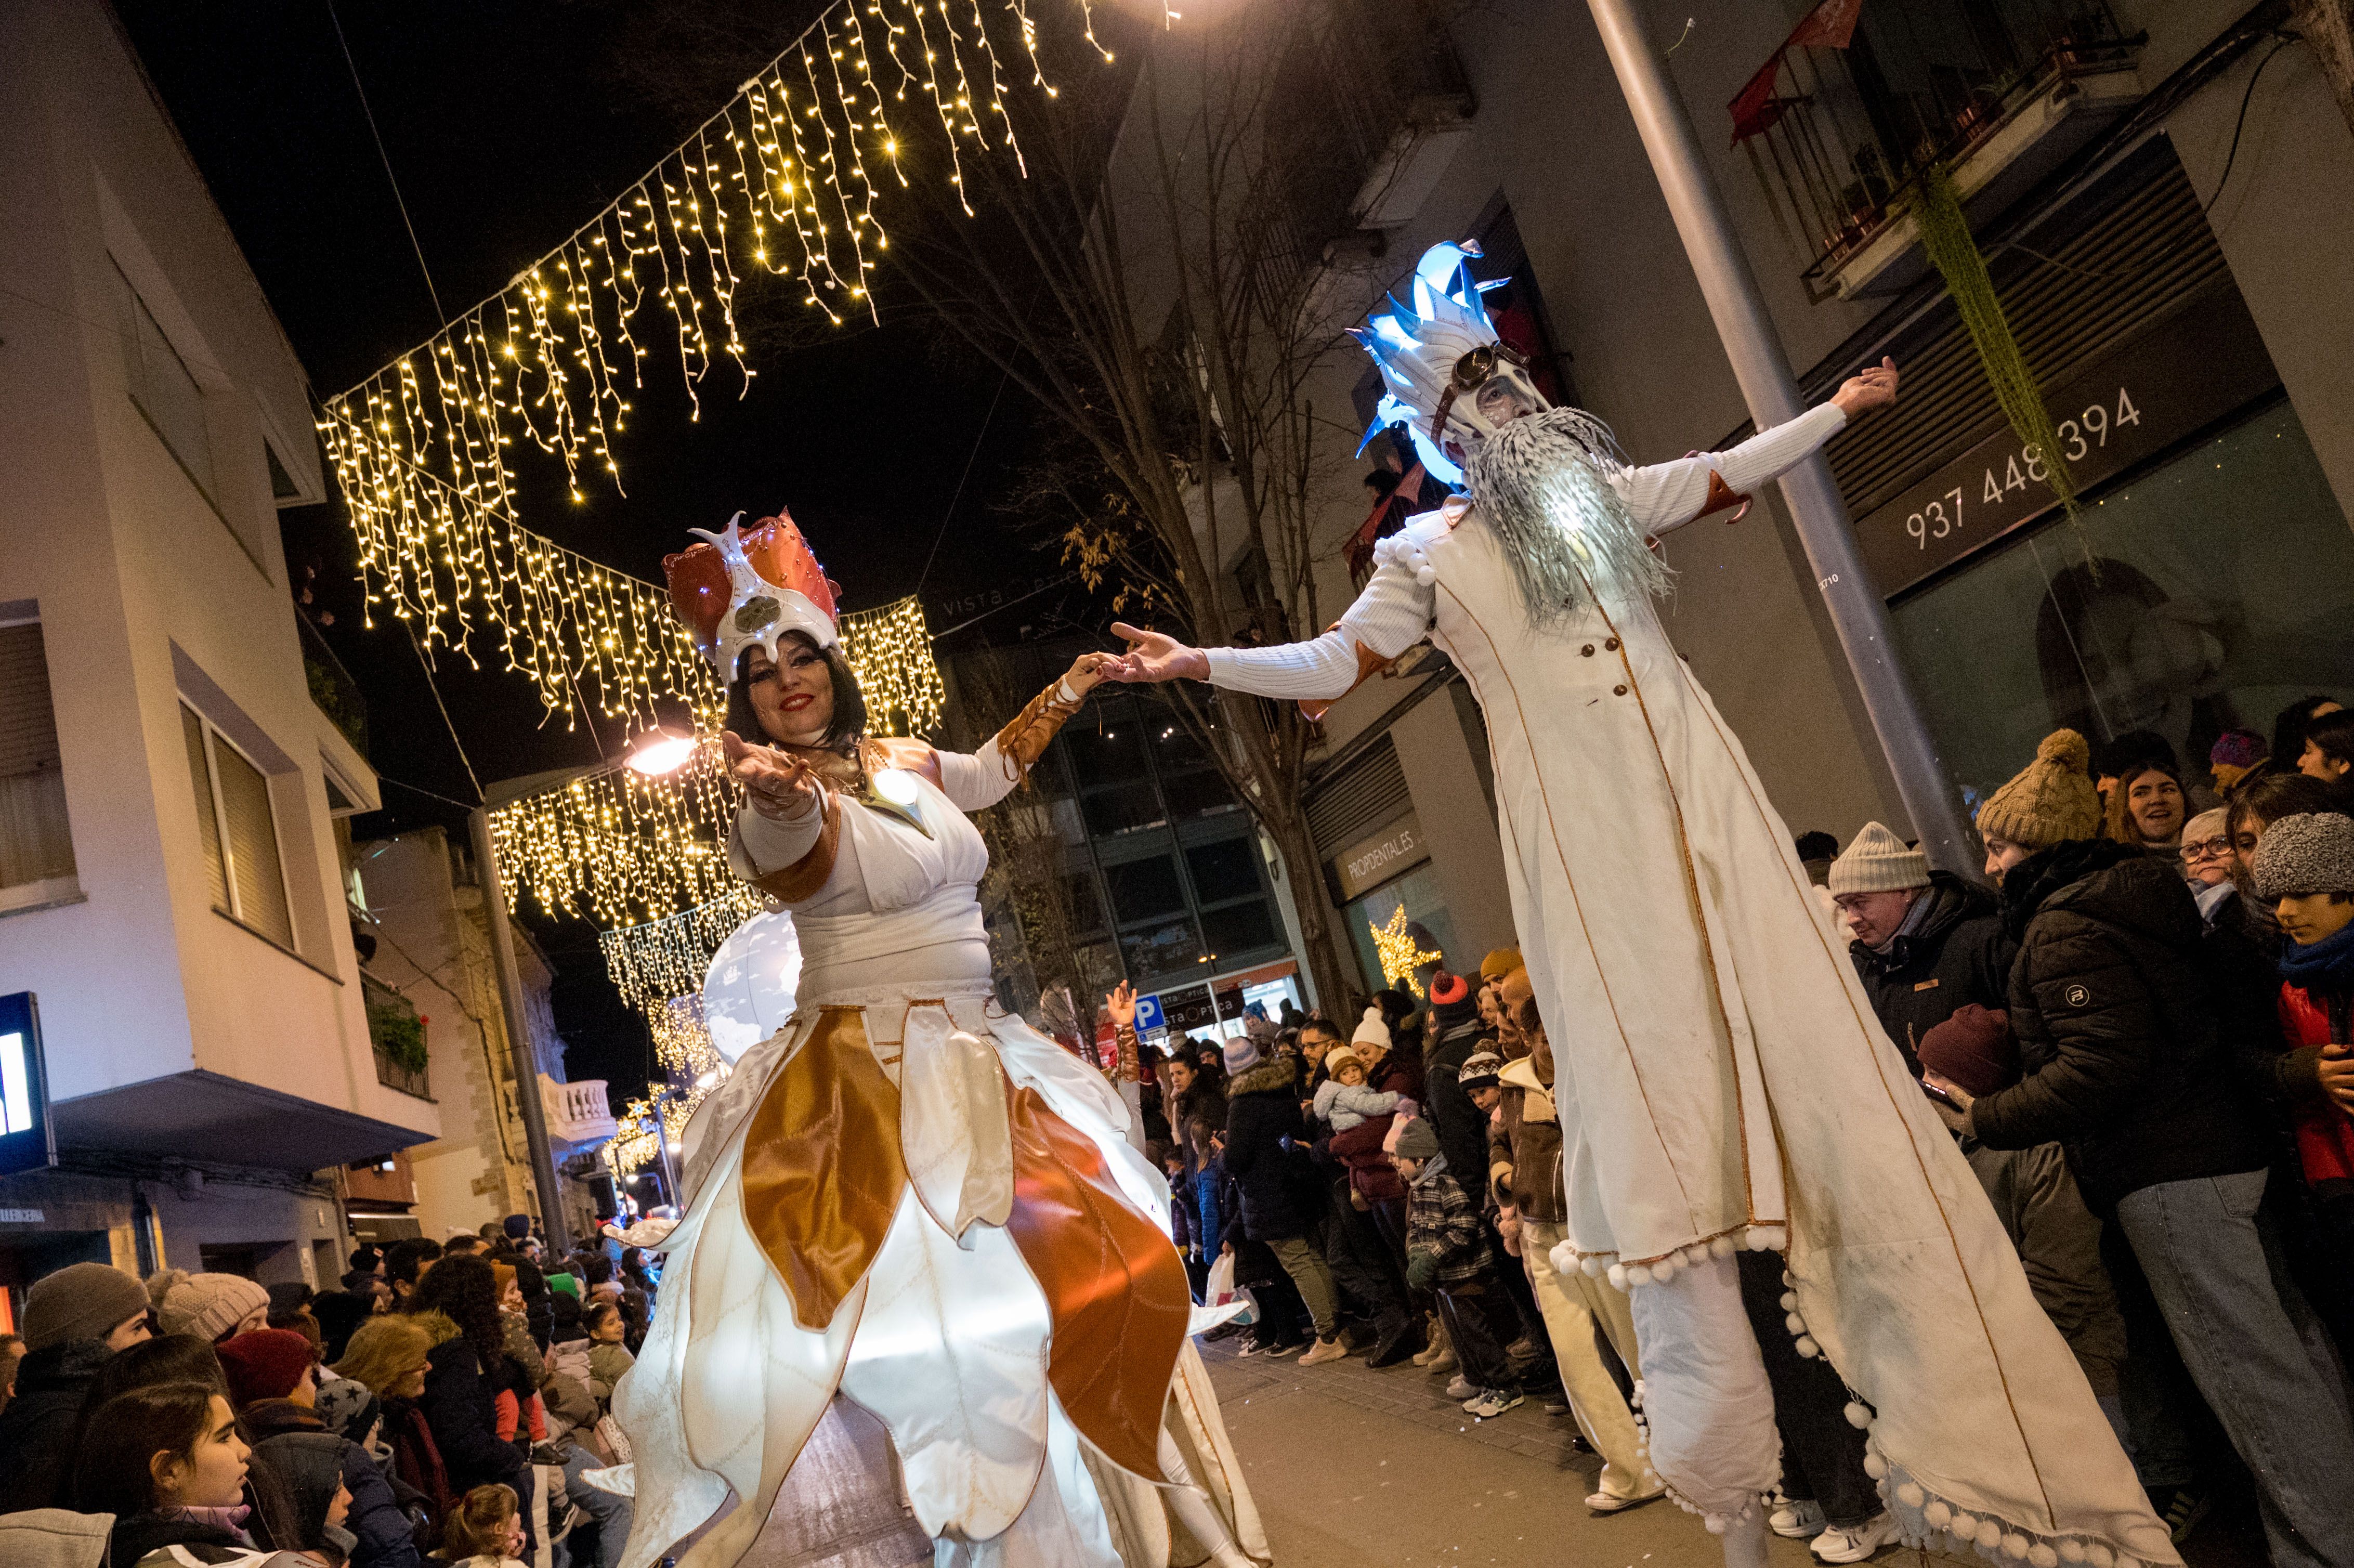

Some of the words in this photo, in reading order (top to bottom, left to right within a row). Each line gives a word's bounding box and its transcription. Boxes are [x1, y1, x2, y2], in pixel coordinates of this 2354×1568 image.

[1906, 487, 1963, 550] 937
[1983, 442, 2049, 504] 448
[2058, 387, 2140, 461] 394
[1348, 831, 1414, 881] PROPDENTAL.ES
[1136, 1000, 1155, 1028] P
